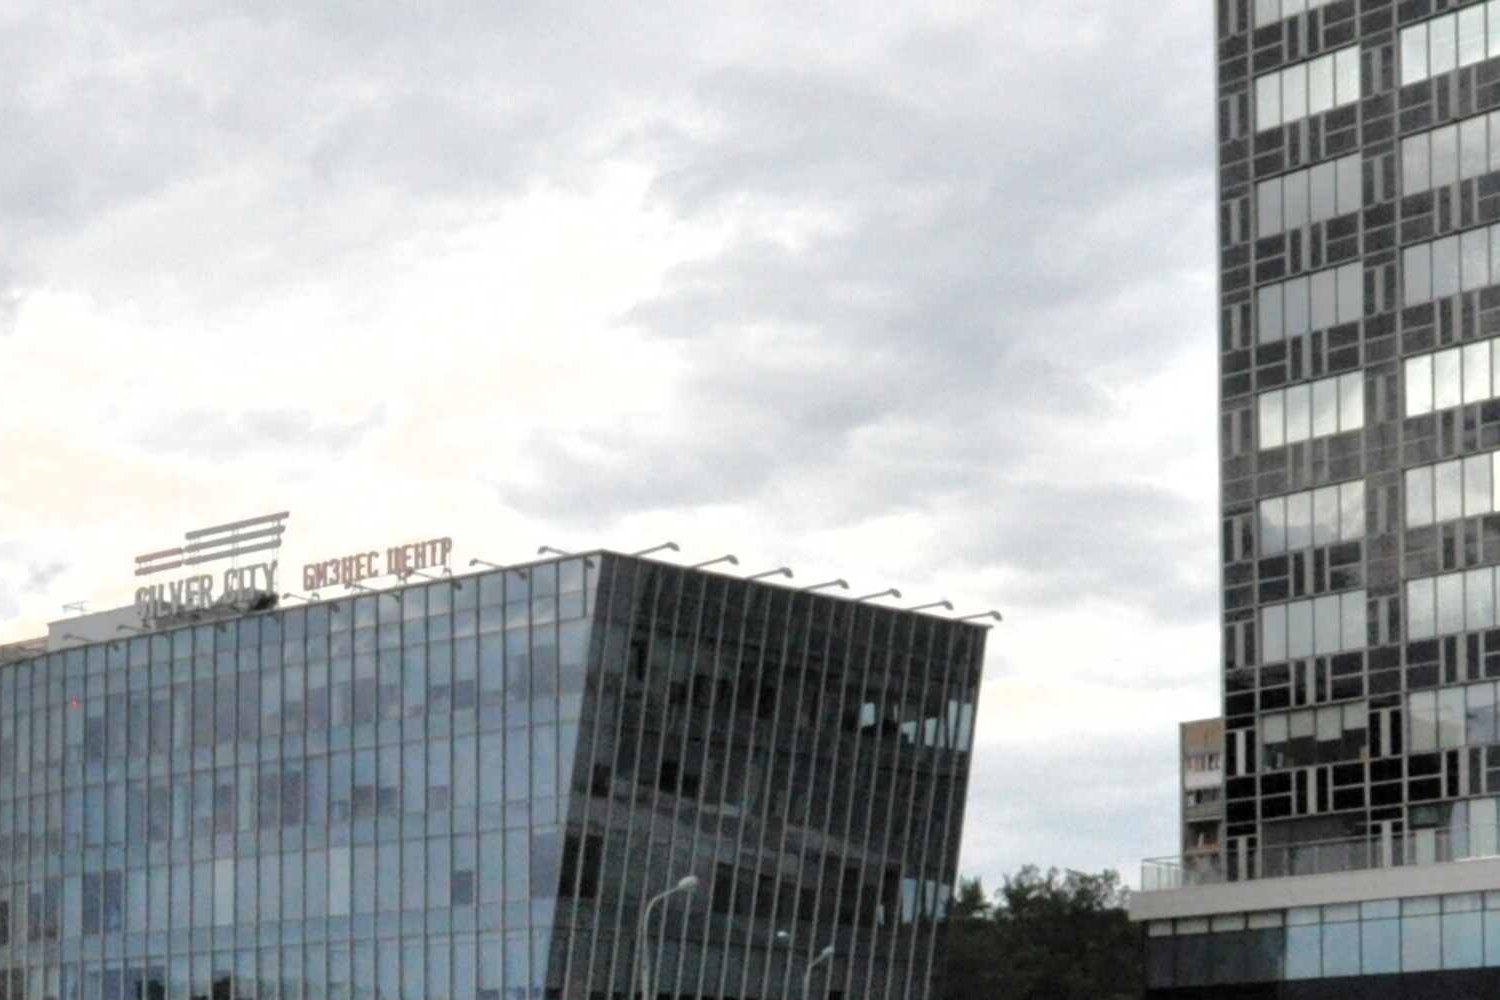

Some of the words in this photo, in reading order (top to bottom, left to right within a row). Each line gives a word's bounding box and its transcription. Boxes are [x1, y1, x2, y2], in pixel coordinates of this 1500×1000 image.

[135, 574, 213, 619] SILVER
[223, 560, 278, 603] CITY
[303, 551, 379, 591] БИЗНЕС
[386, 537, 453, 575] ЦЕНТР
